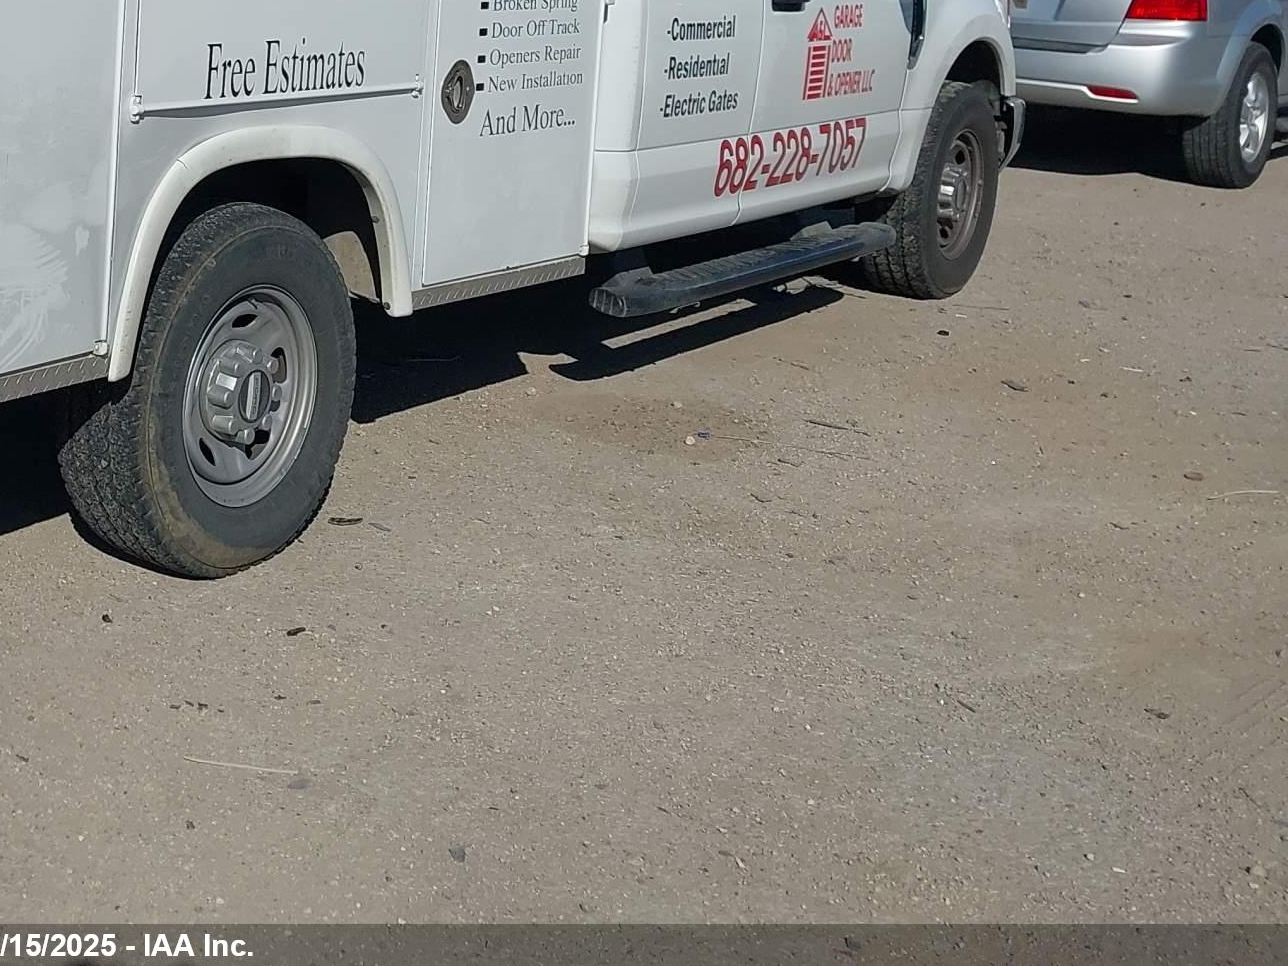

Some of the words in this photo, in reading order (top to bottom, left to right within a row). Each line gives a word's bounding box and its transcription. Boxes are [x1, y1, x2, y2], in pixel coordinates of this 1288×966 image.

[491, 22, 524, 39] Door
[526, 19, 548, 37] Off
[549, 18, 581, 35] Track
[834, 4, 864, 29] GARAGE
[489, 48, 540, 69] Openers
[544, 43, 582, 65] Repair
[831, 38, 852, 63] DOOR
[203, 43, 256, 100] Free
[262, 38, 366, 95] Estimates
[487, 76, 518, 93] New
[521, 71, 583, 90] Installation
[834, 70, 862, 97] OPENER
[861, 69, 875, 93] LLC
[708, 89, 739, 114] Gates
[479, 105, 517, 137] And
[521, 103, 576, 132] More...
[713, 117, 867, 198] 682-228-7057
